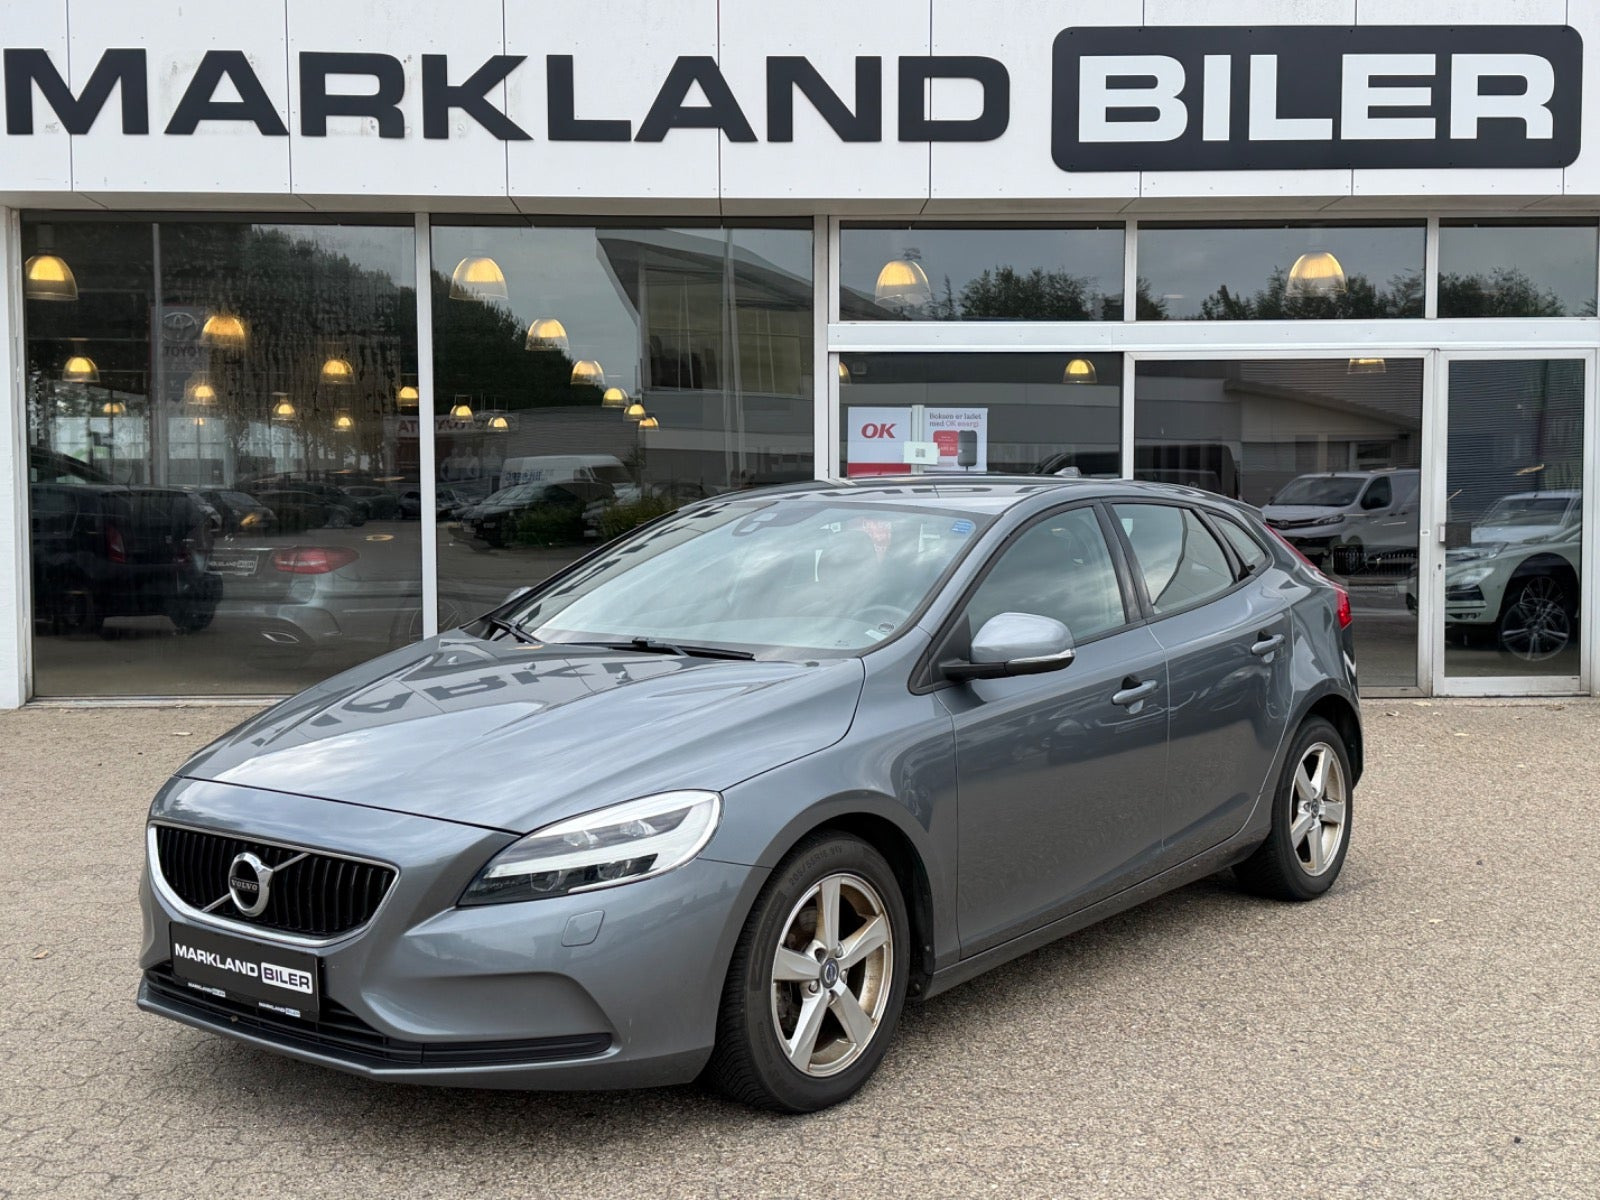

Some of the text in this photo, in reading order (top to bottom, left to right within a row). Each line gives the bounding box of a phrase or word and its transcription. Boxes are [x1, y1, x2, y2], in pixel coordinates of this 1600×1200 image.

[5, 48, 1556, 143] MARKLAND BILER
[963, 412, 982, 420] ladet
[861, 423, 896, 439] OK
[231, 879, 259, 891] VOLVO
[174, 942, 310, 990] MARKLAND BILER
